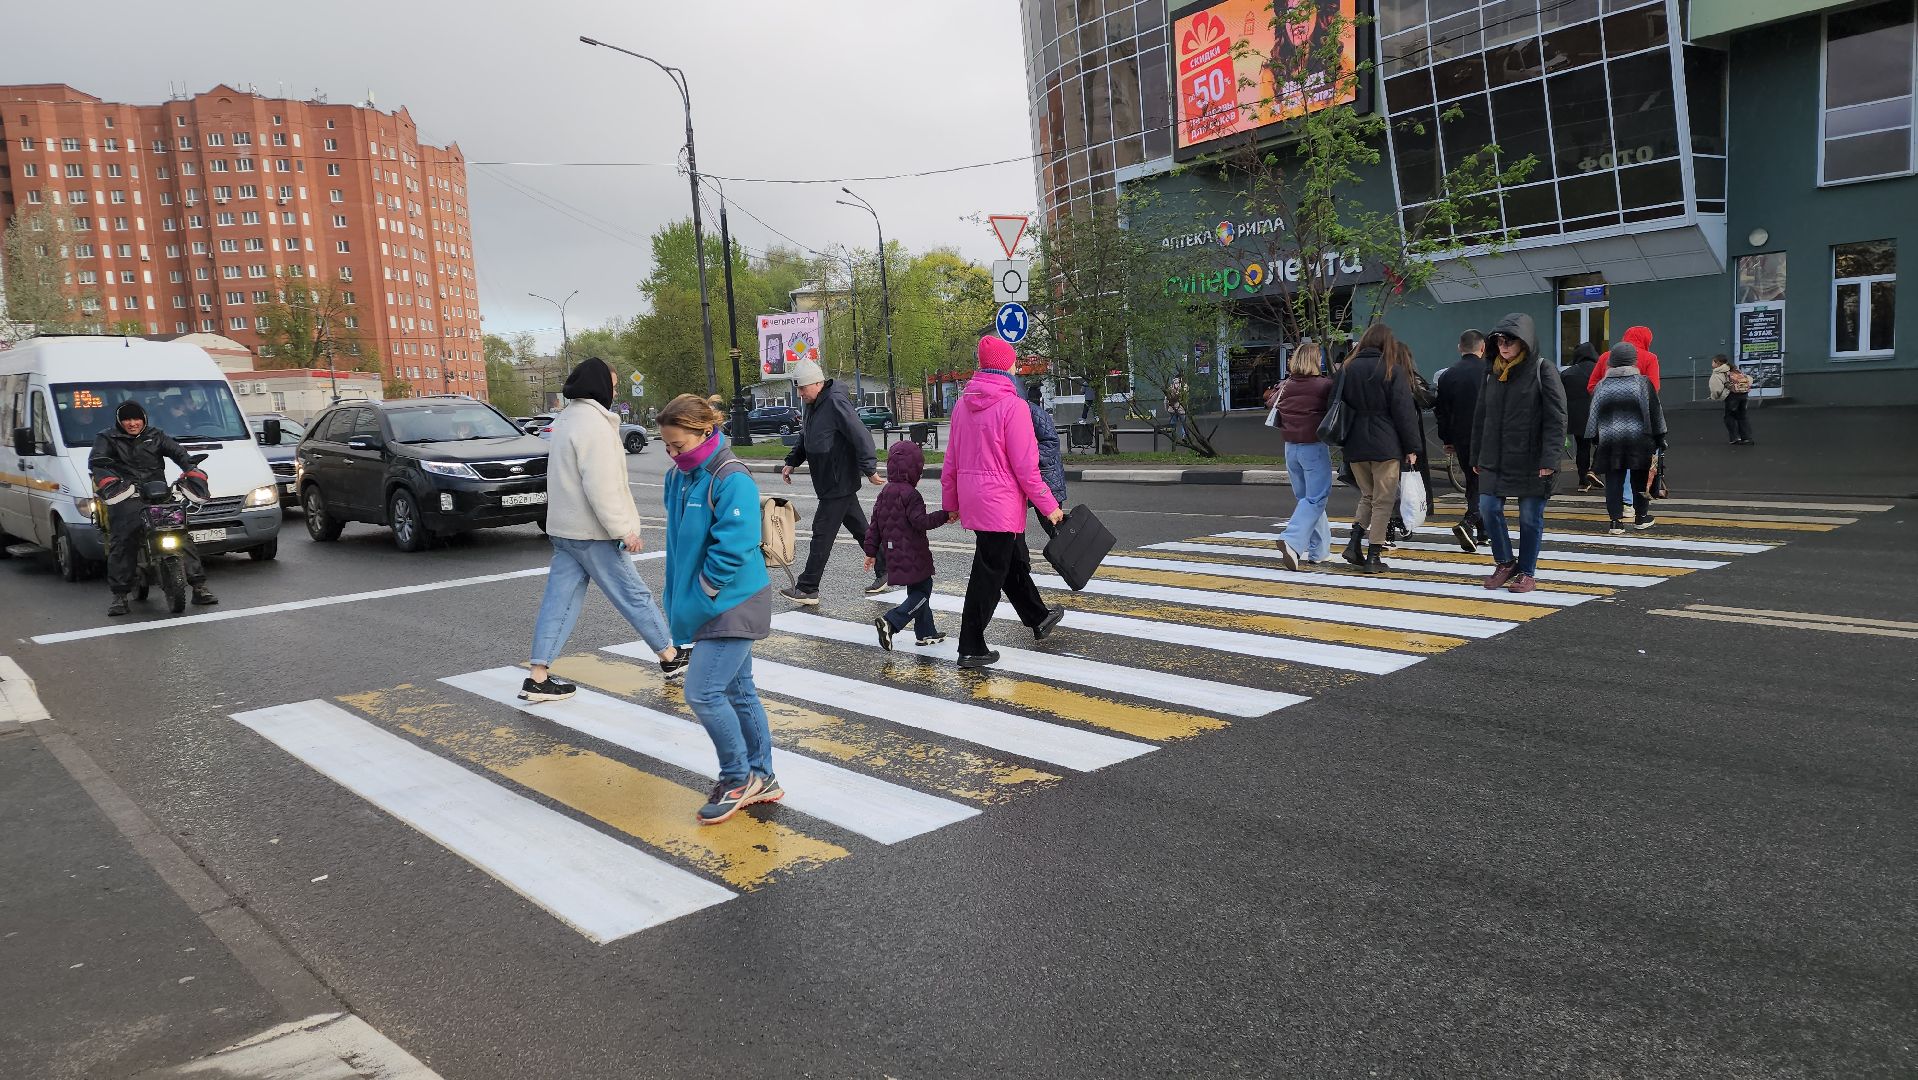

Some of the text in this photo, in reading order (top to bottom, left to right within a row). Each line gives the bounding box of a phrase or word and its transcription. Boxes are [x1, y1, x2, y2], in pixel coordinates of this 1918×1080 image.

[1190, 45, 1221, 69] СКИДКИ
[1578, 145, 1653, 172] ФОТО
[1162, 217, 1285, 249] АПТЕКА РИГЛА
